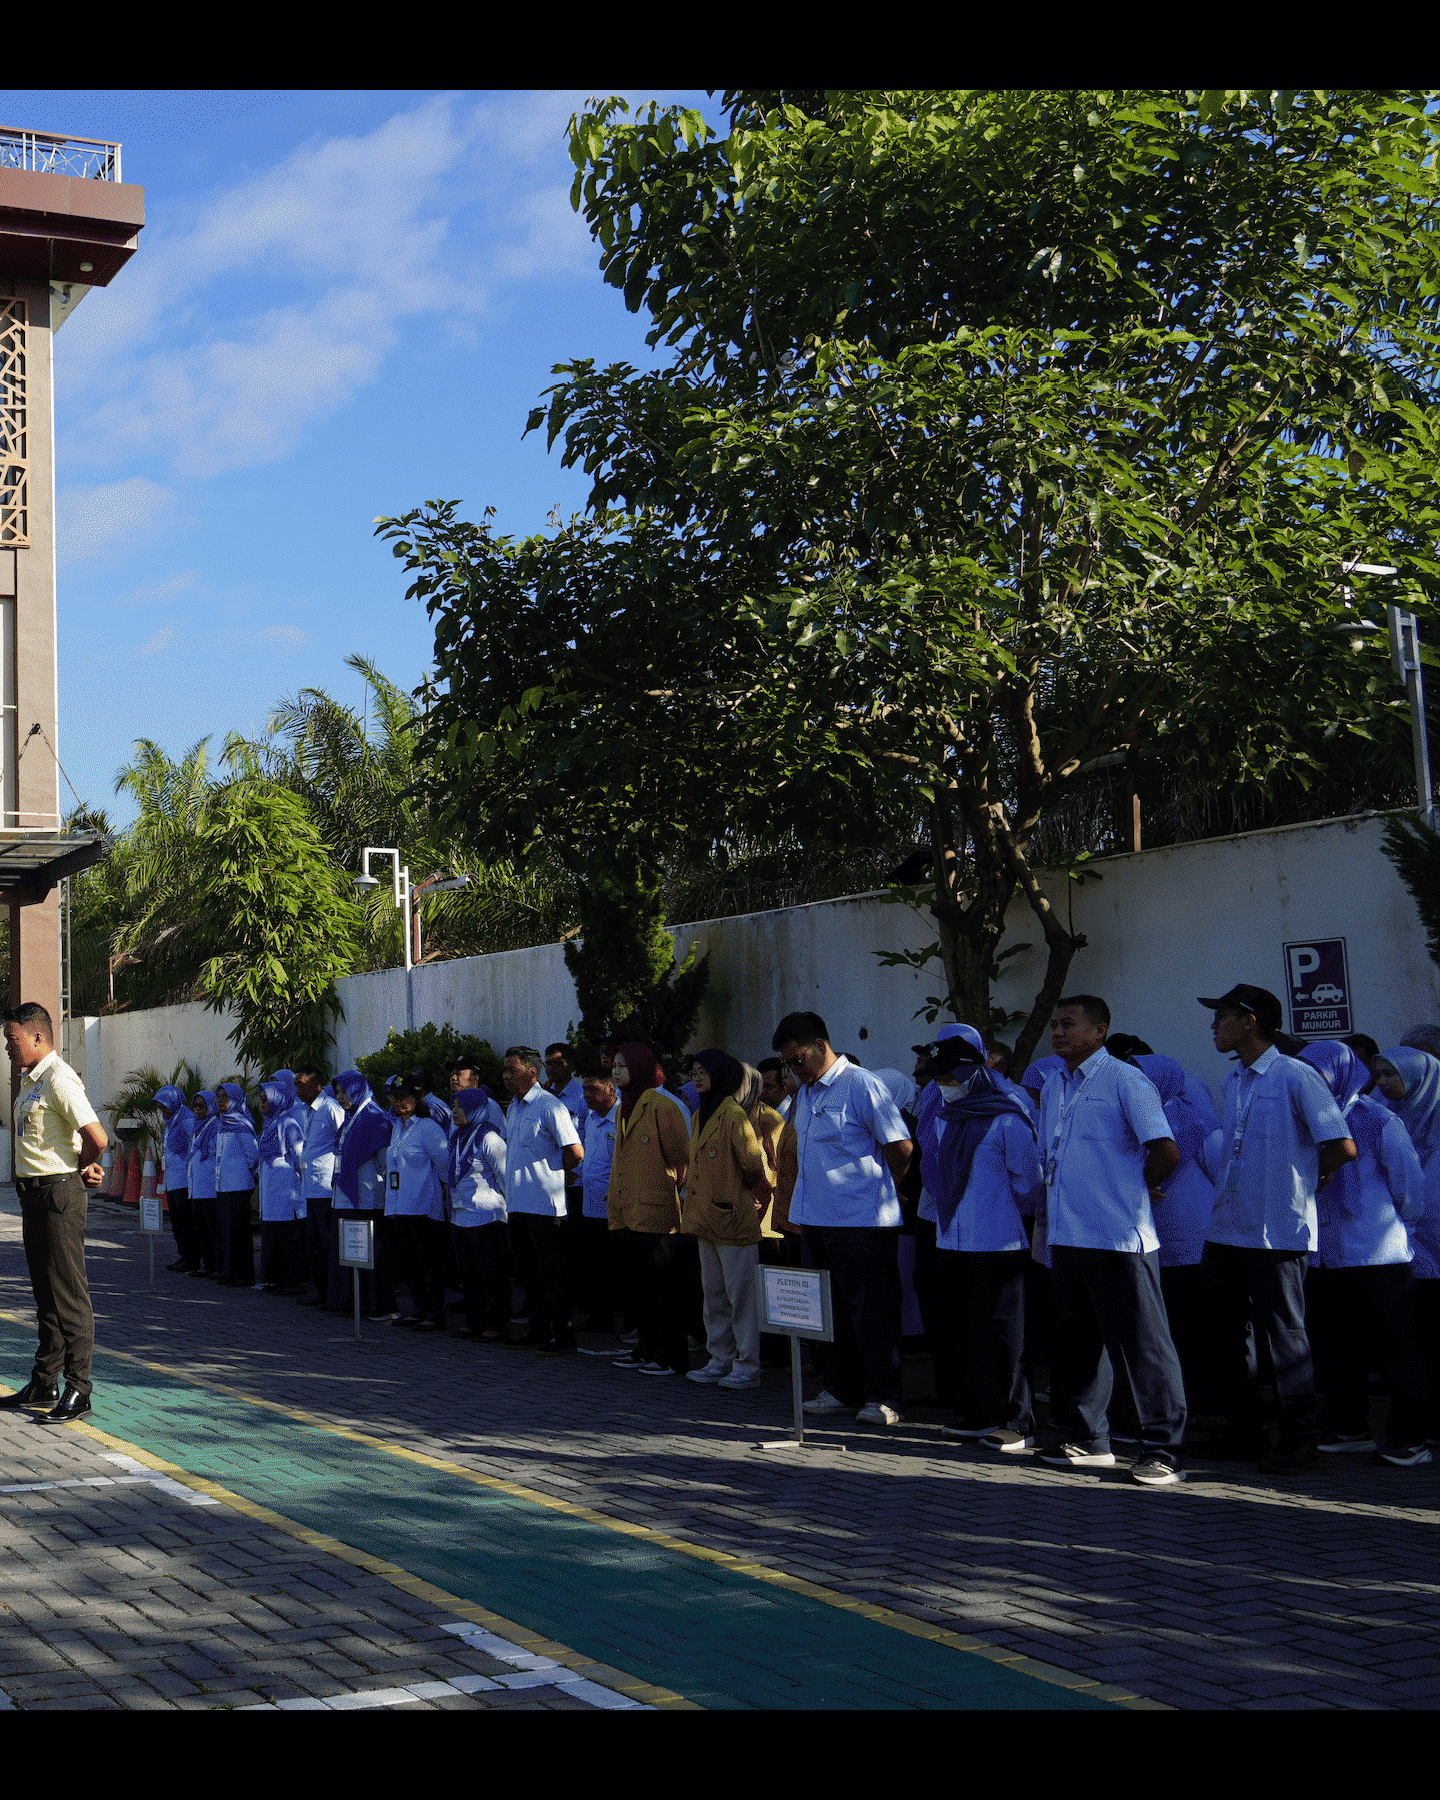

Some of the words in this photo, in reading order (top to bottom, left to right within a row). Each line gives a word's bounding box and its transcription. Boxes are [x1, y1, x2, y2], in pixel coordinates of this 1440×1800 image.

[1290, 947, 1320, 988] P
[1304, 1010, 1338, 1021] PARKIR
[1301, 1020, 1341, 1030] MUNDUR
[777, 1278, 800, 1287] PLETON
